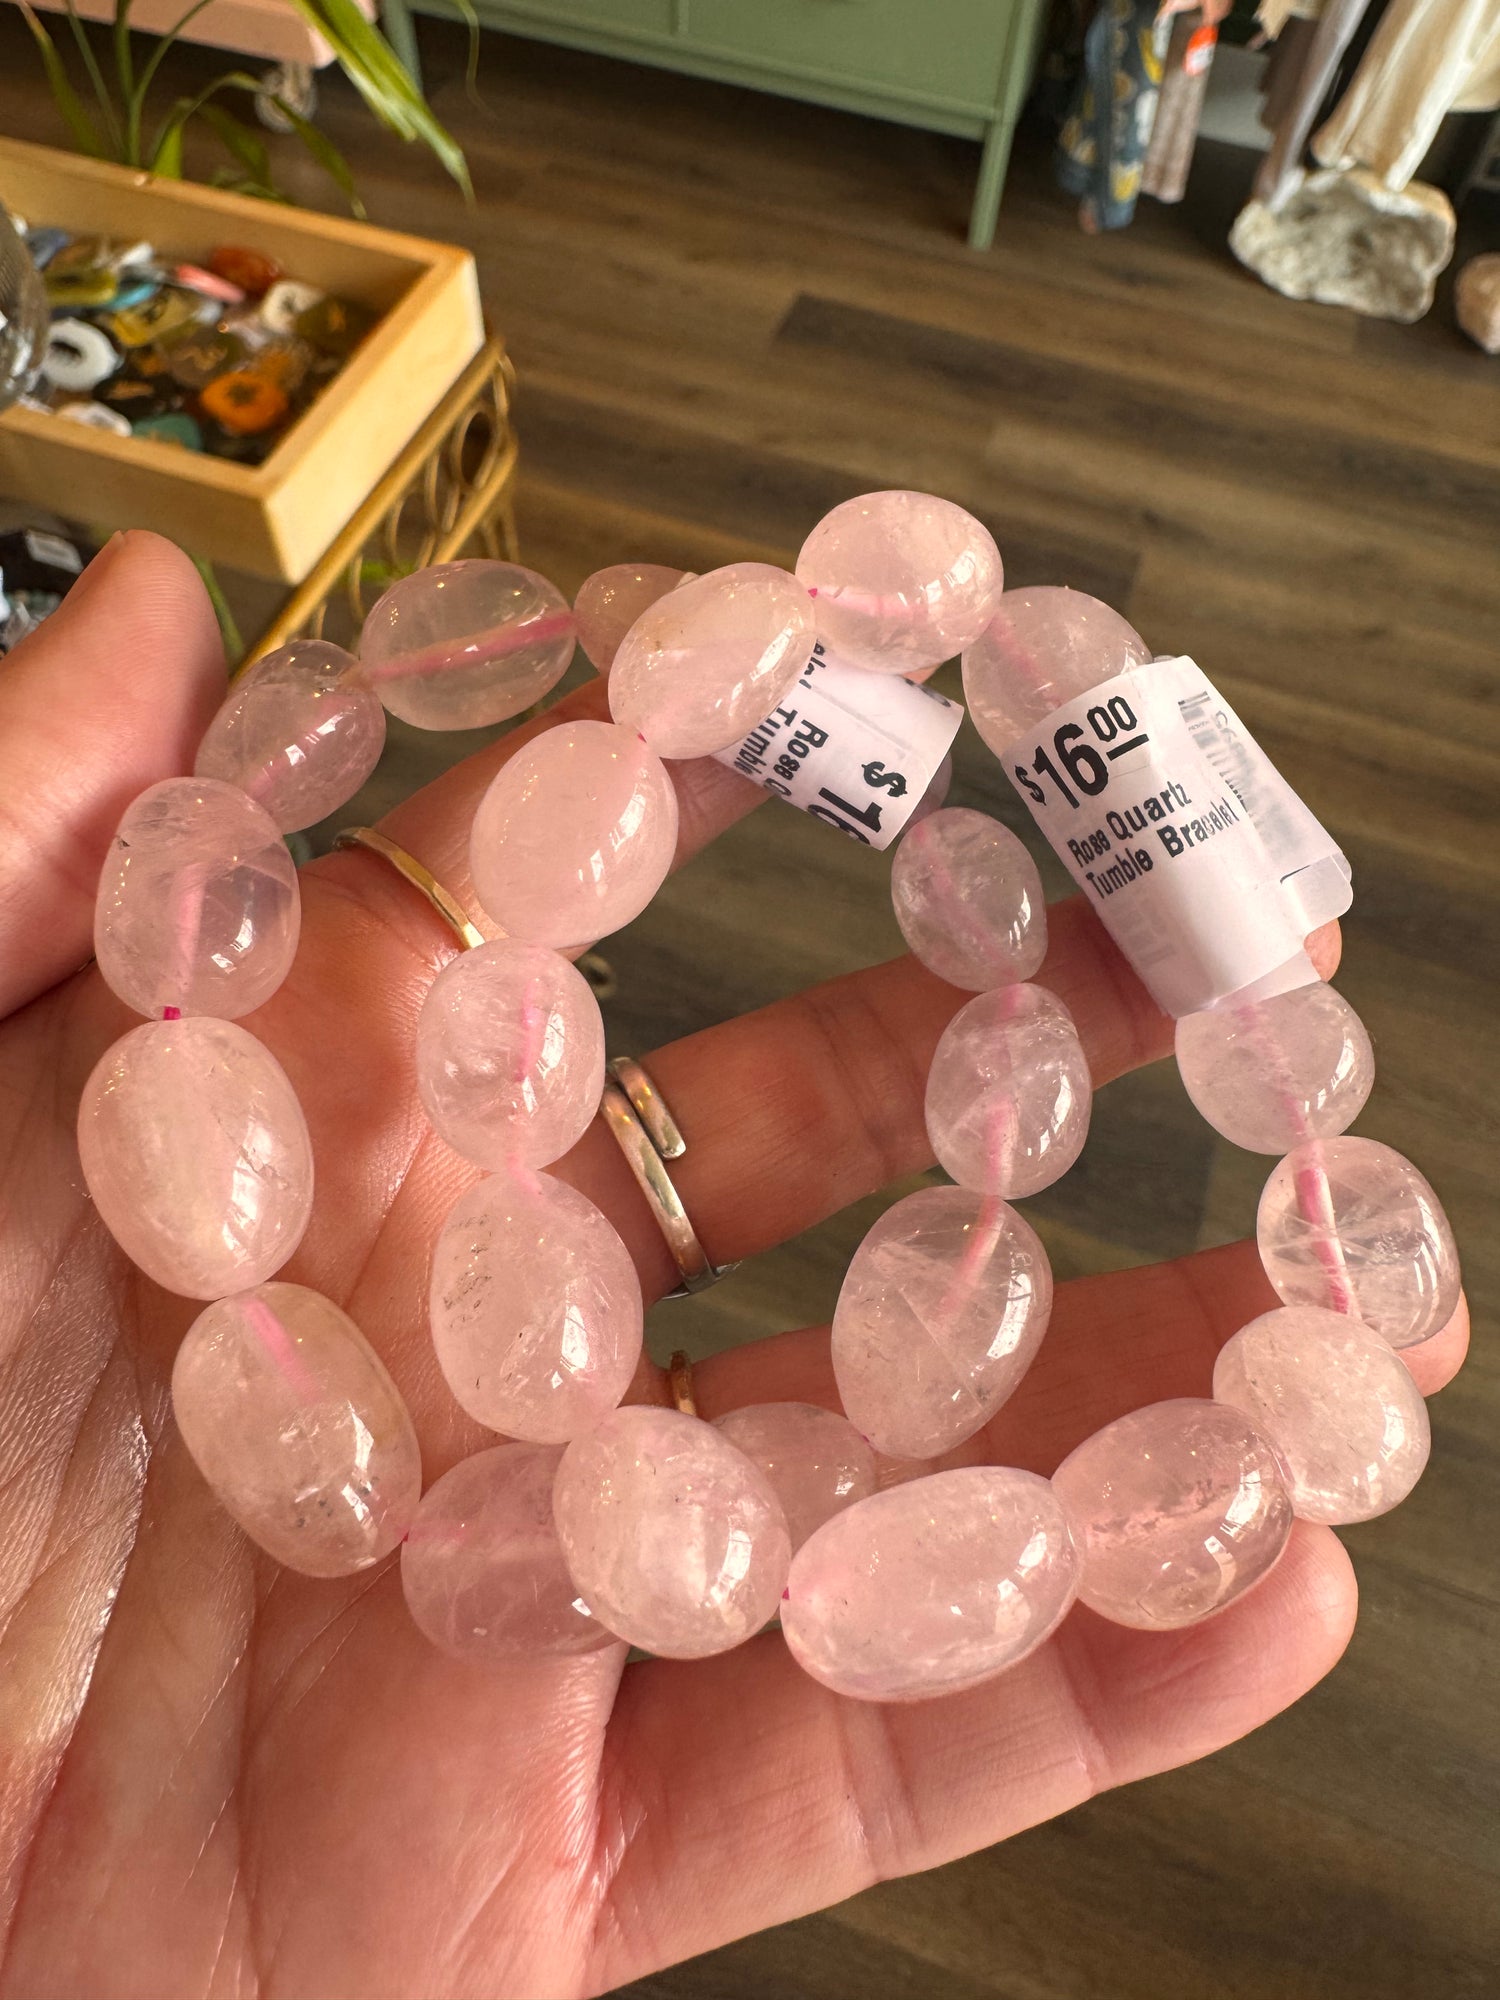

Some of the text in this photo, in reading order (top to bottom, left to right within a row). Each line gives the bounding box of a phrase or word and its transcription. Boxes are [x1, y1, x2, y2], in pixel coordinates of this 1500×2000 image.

[773, 719, 829, 781] Rose
[1066, 780, 1192, 868] Rose Quartz
[1085, 796, 1240, 899] Tumble Bracelet
